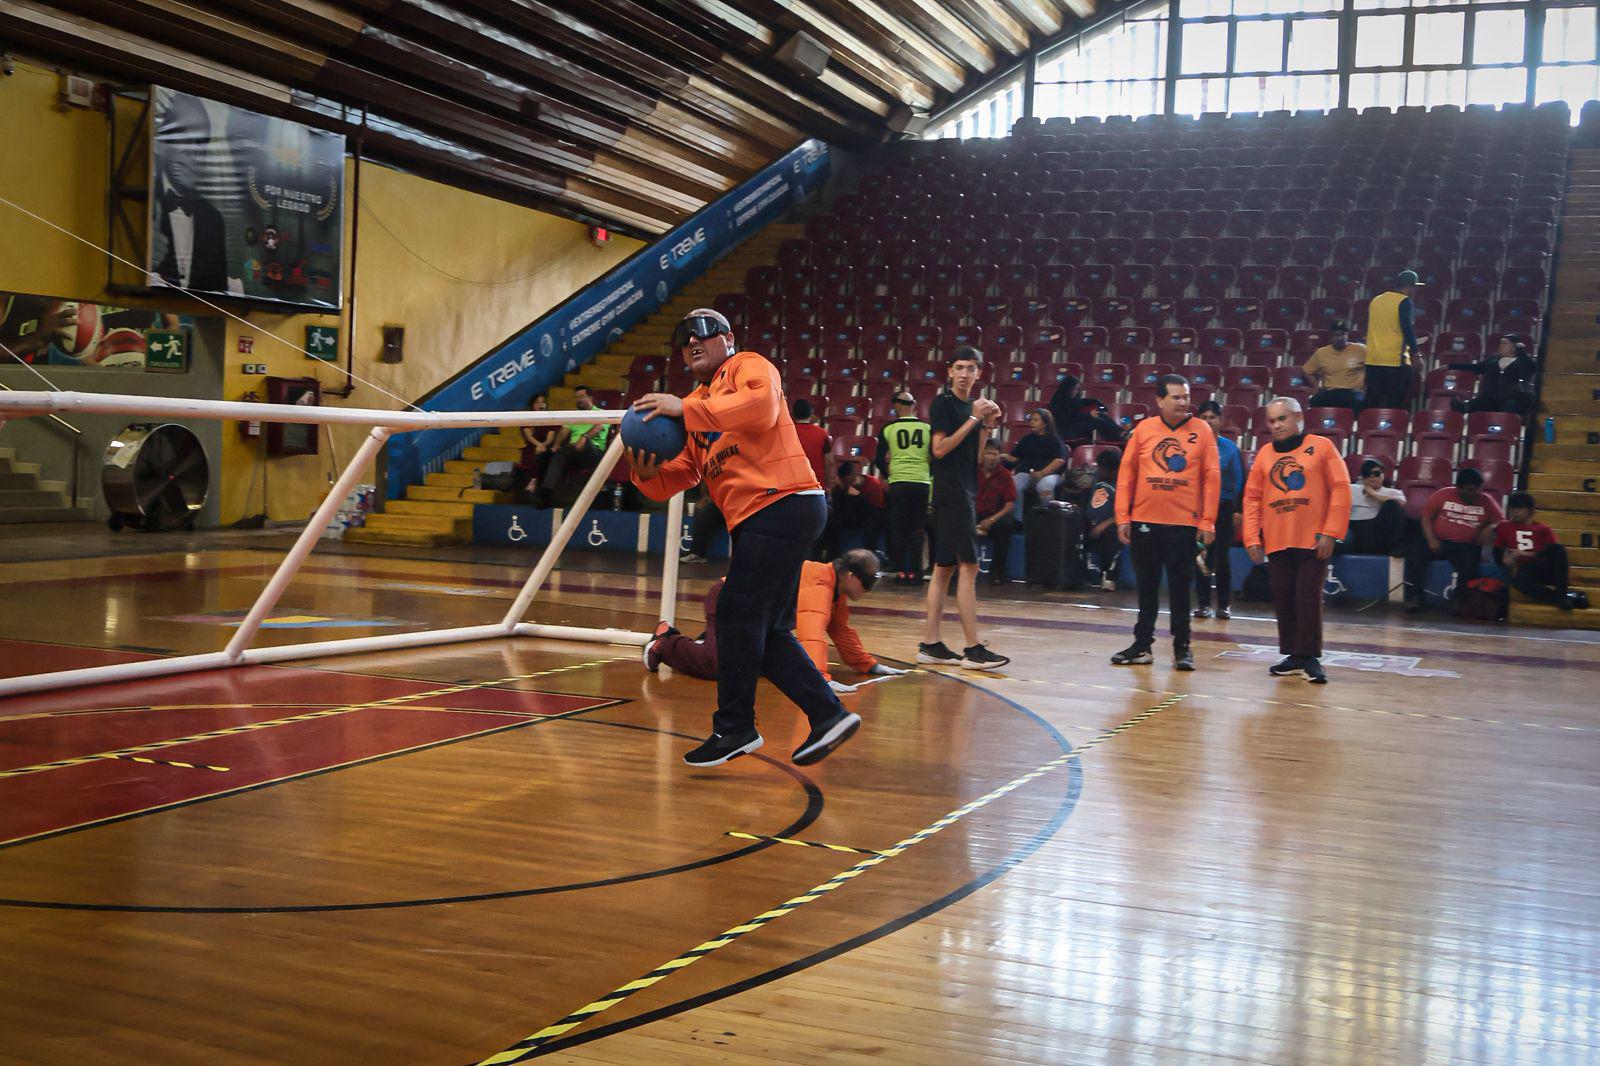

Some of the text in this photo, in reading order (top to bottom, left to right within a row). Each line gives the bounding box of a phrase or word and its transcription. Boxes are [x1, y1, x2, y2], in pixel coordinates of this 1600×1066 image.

[897, 429, 924, 450] 04
[1187, 432, 1198, 444] 2
[716, 444, 740, 465] QUIERE
[1303, 446, 1314, 456] 4
[1516, 530, 1534, 551] 5
